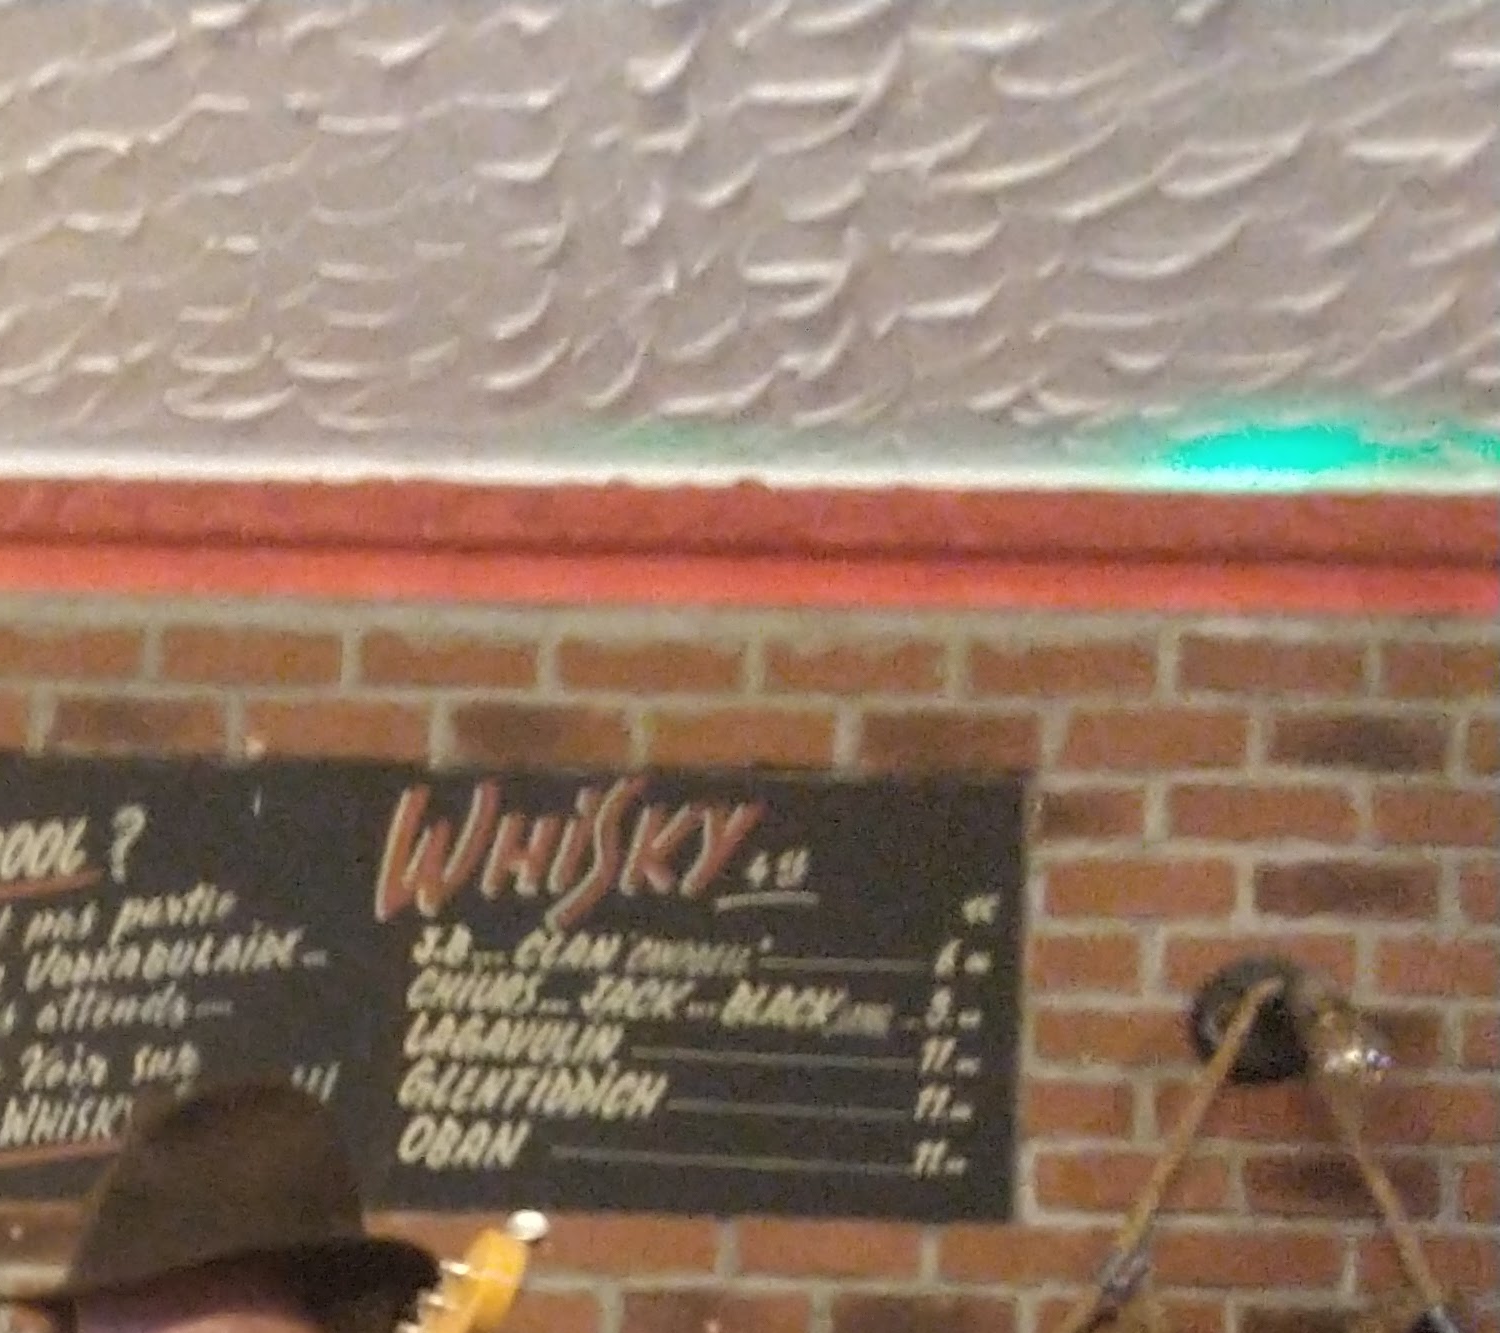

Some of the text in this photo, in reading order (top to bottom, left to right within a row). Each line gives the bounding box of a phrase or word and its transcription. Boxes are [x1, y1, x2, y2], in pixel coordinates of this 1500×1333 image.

[24, 902, 98, 947] pas
[109, 882, 238, 948] partie
[397, 1113, 532, 1172] OBAN
